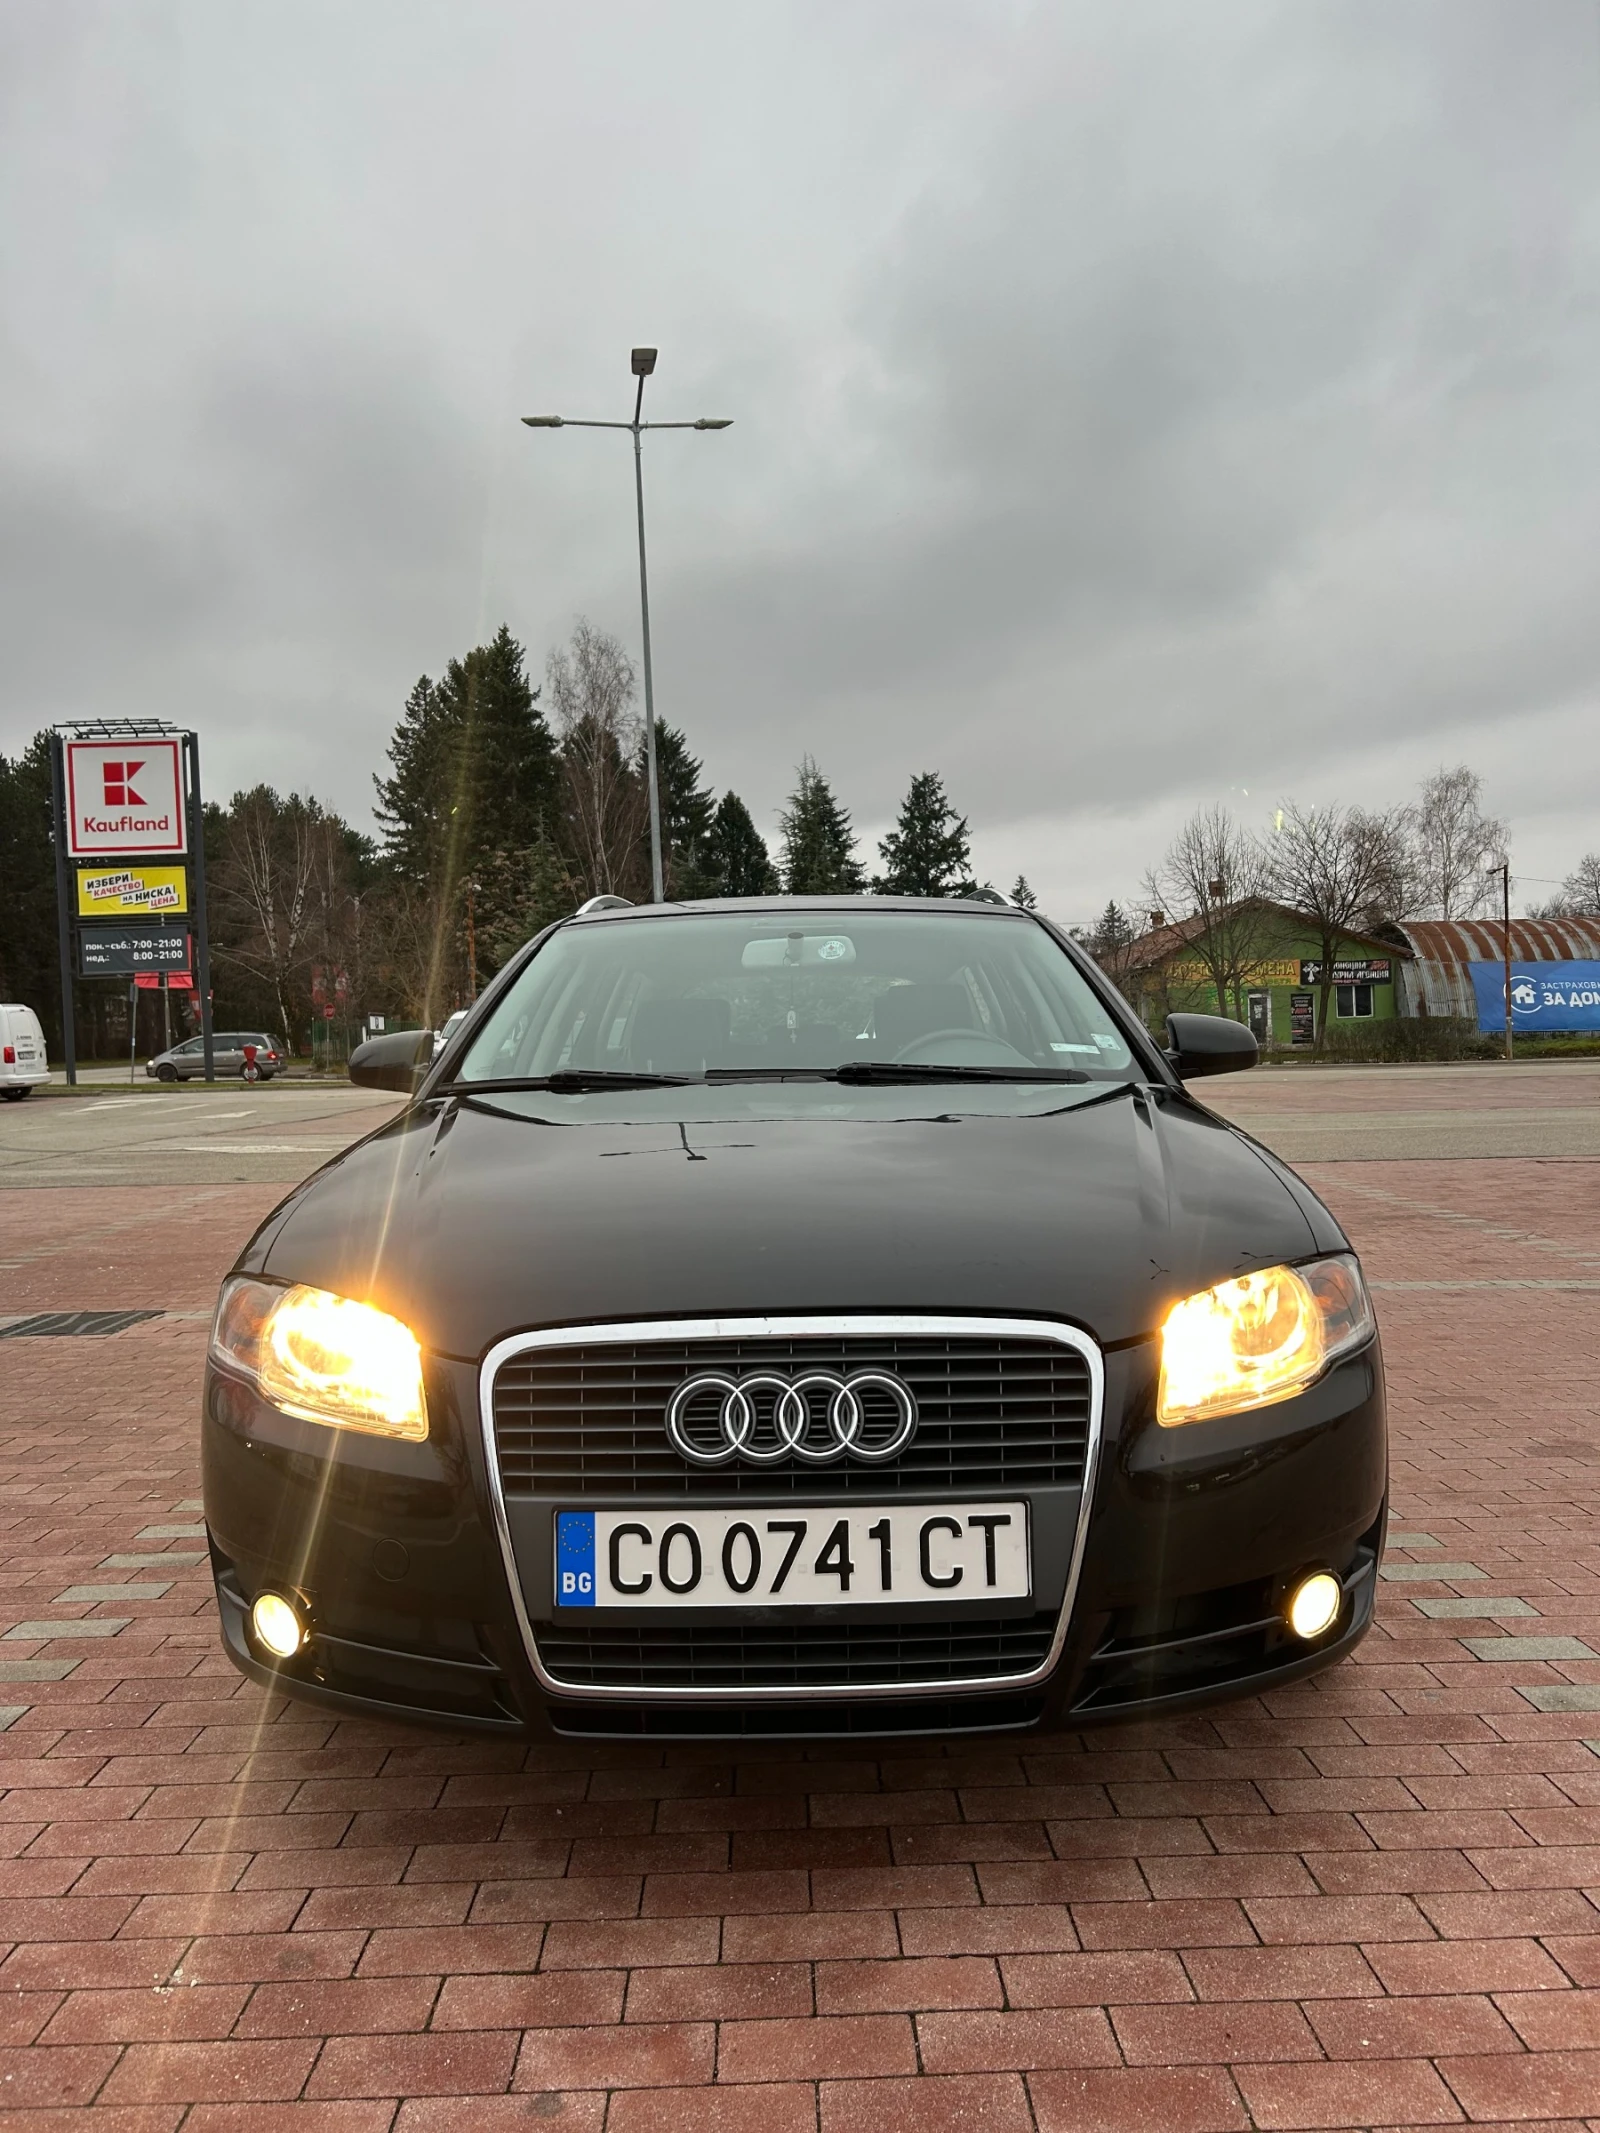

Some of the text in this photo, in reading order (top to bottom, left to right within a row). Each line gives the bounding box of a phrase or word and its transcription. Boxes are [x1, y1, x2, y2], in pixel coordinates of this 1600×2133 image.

[84, 815, 169, 833] Kaufland
[87, 873, 129, 890] ИЗБЕРИ
[93, 881, 141, 897] КАЧЕСТВО
[135, 886, 171, 902] НИСКА
[150, 896, 175, 907] ЦЕНА
[86, 954, 110, 963] нед.:
[1543, 992, 1566, 1005] ЗА
[722, 1519, 895, 1594] 0741
[562, 1573, 592, 1593] BG
